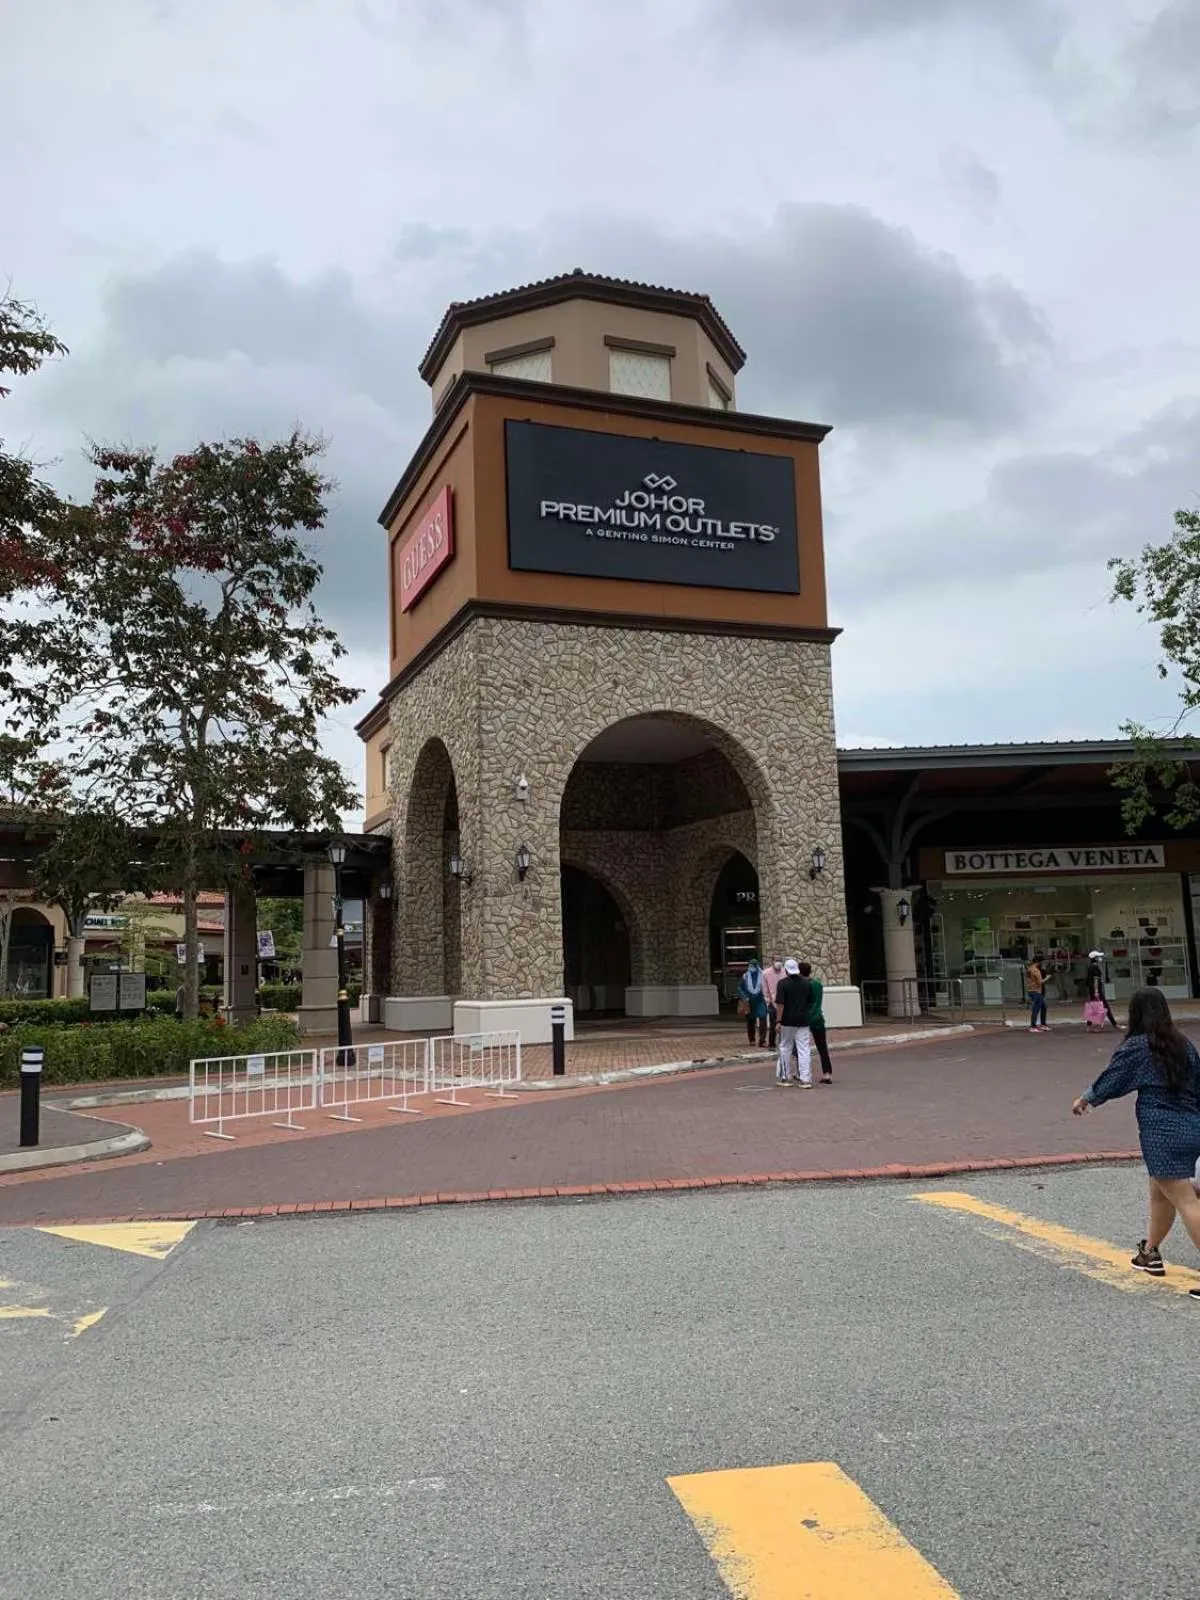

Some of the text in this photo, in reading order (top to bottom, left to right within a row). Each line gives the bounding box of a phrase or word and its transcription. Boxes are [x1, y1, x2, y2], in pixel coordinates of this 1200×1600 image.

[540, 500, 661, 530] PREMIUM
[615, 490, 705, 515] JOHOR
[403, 512, 442, 590] GUESS
[586, 528, 735, 550] A GENTING SIMON CENTER
[954, 848, 1159, 870] BOTTEGA VENETA
